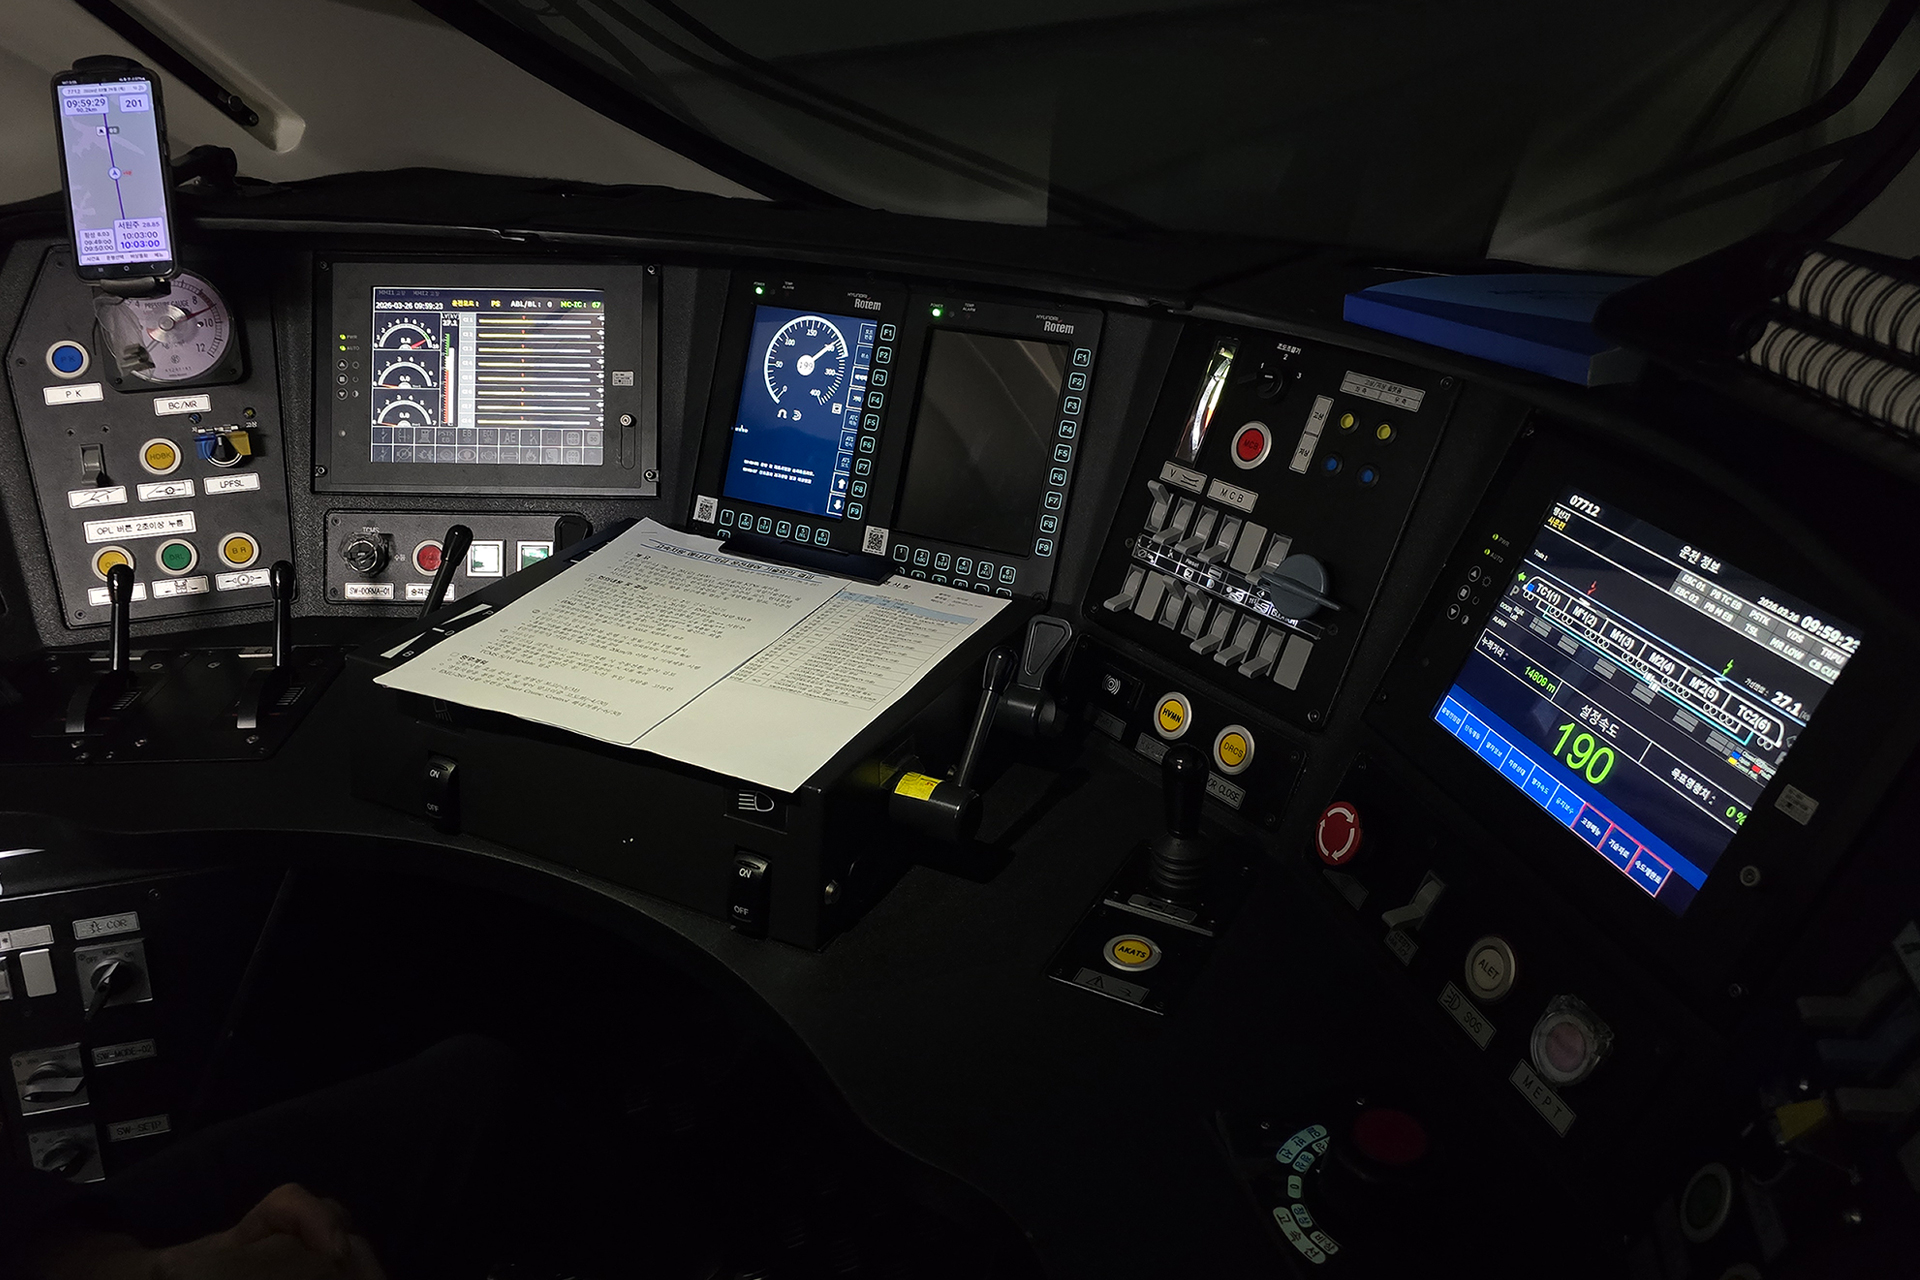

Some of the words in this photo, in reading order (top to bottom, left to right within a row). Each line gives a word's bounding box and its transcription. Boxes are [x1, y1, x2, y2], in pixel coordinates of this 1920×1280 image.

[66, 98, 106, 108] 09:59:29
[125, 99, 143, 108] 201
[122, 231, 158, 240] 10:03:00
[120, 240, 160, 250] 10:03:00
[192, 296, 198, 305] 8
[376, 302, 413, 310] 2026-03-26
[414, 302, 444, 310] 09:59:23
[854, 298, 882, 312] Rotem
[203, 318, 214, 328] 10
[1043, 320, 1075, 336] Rotem
[884, 328, 892, 337] F1
[195, 343, 206, 353] 12
[879, 351, 888, 360] F2
[1076, 353, 1087, 363] F1
[1260, 362, 1265, 370] 1
[874, 374, 884, 382] F3
[1072, 376, 1082, 386] F2
[1296, 372, 1303, 380] 3
[167, 400, 198, 410] BC/MR
[870, 396, 880, 404] F4
[1066, 402, 1078, 411] F3
[866, 418, 876, 426] F5
[1062, 425, 1073, 434] F4
[504, 432, 516, 444] AE
[862, 440, 872, 448] F6
[1244, 440, 1260, 451] MCB
[1057, 449, 1068, 458] F5
[858, 462, 868, 470] F7
[1052, 472, 1064, 482] F6
[1170, 468, 1177, 478] V
[854, 484, 864, 493] F8
[1048, 496, 1059, 505] F7
[1220, 488, 1244, 503] MCB
[850, 507, 860, 515] F9
[1569, 494, 1601, 518] 07712
[1552, 506, 1572, 522] 행선지
[96, 526, 114, 536] OPL
[116, 524, 133, 533] 버튼
[136, 520, 165, 532] 2초이상
[168, 518, 184, 528] 누름
[1043, 520, 1054, 528] F8
[1038, 542, 1050, 552] F9
[1498, 536, 1510, 548] PWR
[1186, 558, 1200, 569] Reset
[1490, 552, 1504, 564] AUTO
[1678, 546, 1700, 564] 운전
[1700, 554, 1722, 574] 정보
[1682, 574, 1697, 589] EBC
[1695, 582, 1706, 592] 01
[1510, 585, 1520, 596] P
[1536, 583, 1562, 606] TC1(1)
[1674, 586, 1690, 599] EBC
[1688, 592, 1700, 605] 02
[1710, 588, 1721, 599] PB
[1720, 594, 1732, 606] TC
[1730, 600, 1743, 612] EB
[1703, 602, 1716, 613] PB
[1714, 608, 1723, 618] M
[1722, 611, 1734, 623] EB
[1757, 596, 1800, 624] 2026.03.26
[1748, 610, 1772, 626] PSTK
[1744, 623, 1759, 637] TSL
[1786, 628, 1805, 644] VDS
[1610, 628, 1636, 650] M1(3)
[1769, 637, 1784, 650] MR
[1782, 644, 1805, 660] LOW
[1820, 646, 1846, 665] TRPU
[1481, 636, 1506, 658] 누적거리
[1546, 682, 1556, 694] m
[1648, 652, 1676, 676] M2(4)
[1808, 658, 1824, 672] CB
[1821, 666, 1840, 680] CUT
[1770, 691, 1804, 717] 27.1
[1162, 708, 1182, 724] HVMN
[1579, 704, 1620, 739] 설정속도
[1736, 704, 1772, 734] TC2(6)
[1223, 742, 1244, 758] DRCS
[1552, 722, 1616, 785] 190
[428, 768, 441, 780] ON
[1218, 785, 1241, 802] CLOSE
[426, 802, 440, 813] OFF
[1726, 806, 1737, 819] 0
[1736, 812, 1748, 826] %
[738, 867, 752, 880] ON
[733, 904, 750, 917] OFF
[106, 918, 128, 929] COR
[1118, 945, 1147, 958] AKATS
[1478, 958, 1500, 981] ALET
[1462, 1010, 1484, 1034] SOS
[1276, 1213, 1320, 1260] 고속선
